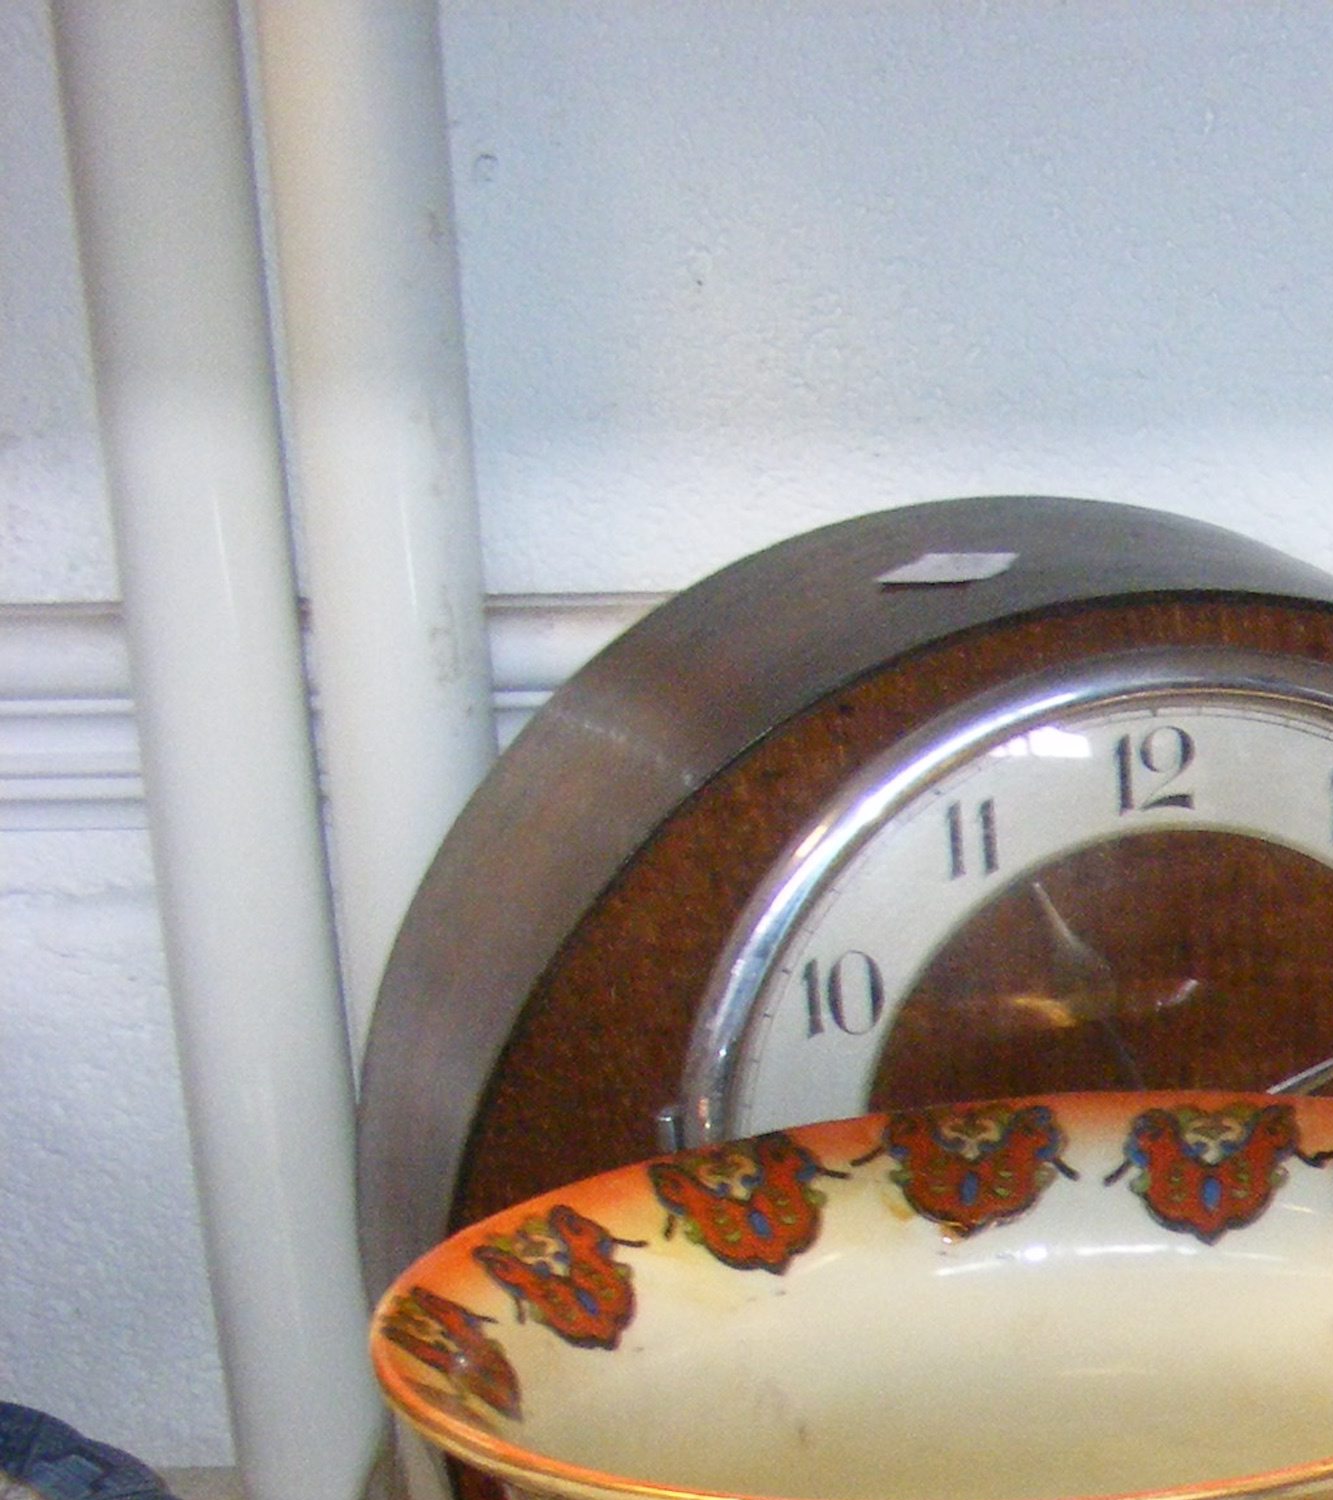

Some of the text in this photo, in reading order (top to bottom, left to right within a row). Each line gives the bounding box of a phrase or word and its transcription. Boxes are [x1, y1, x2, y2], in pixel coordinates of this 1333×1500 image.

[1115, 726, 1196, 811] 12
[945, 799, 999, 881] 11
[801, 949, 884, 1037] 10
